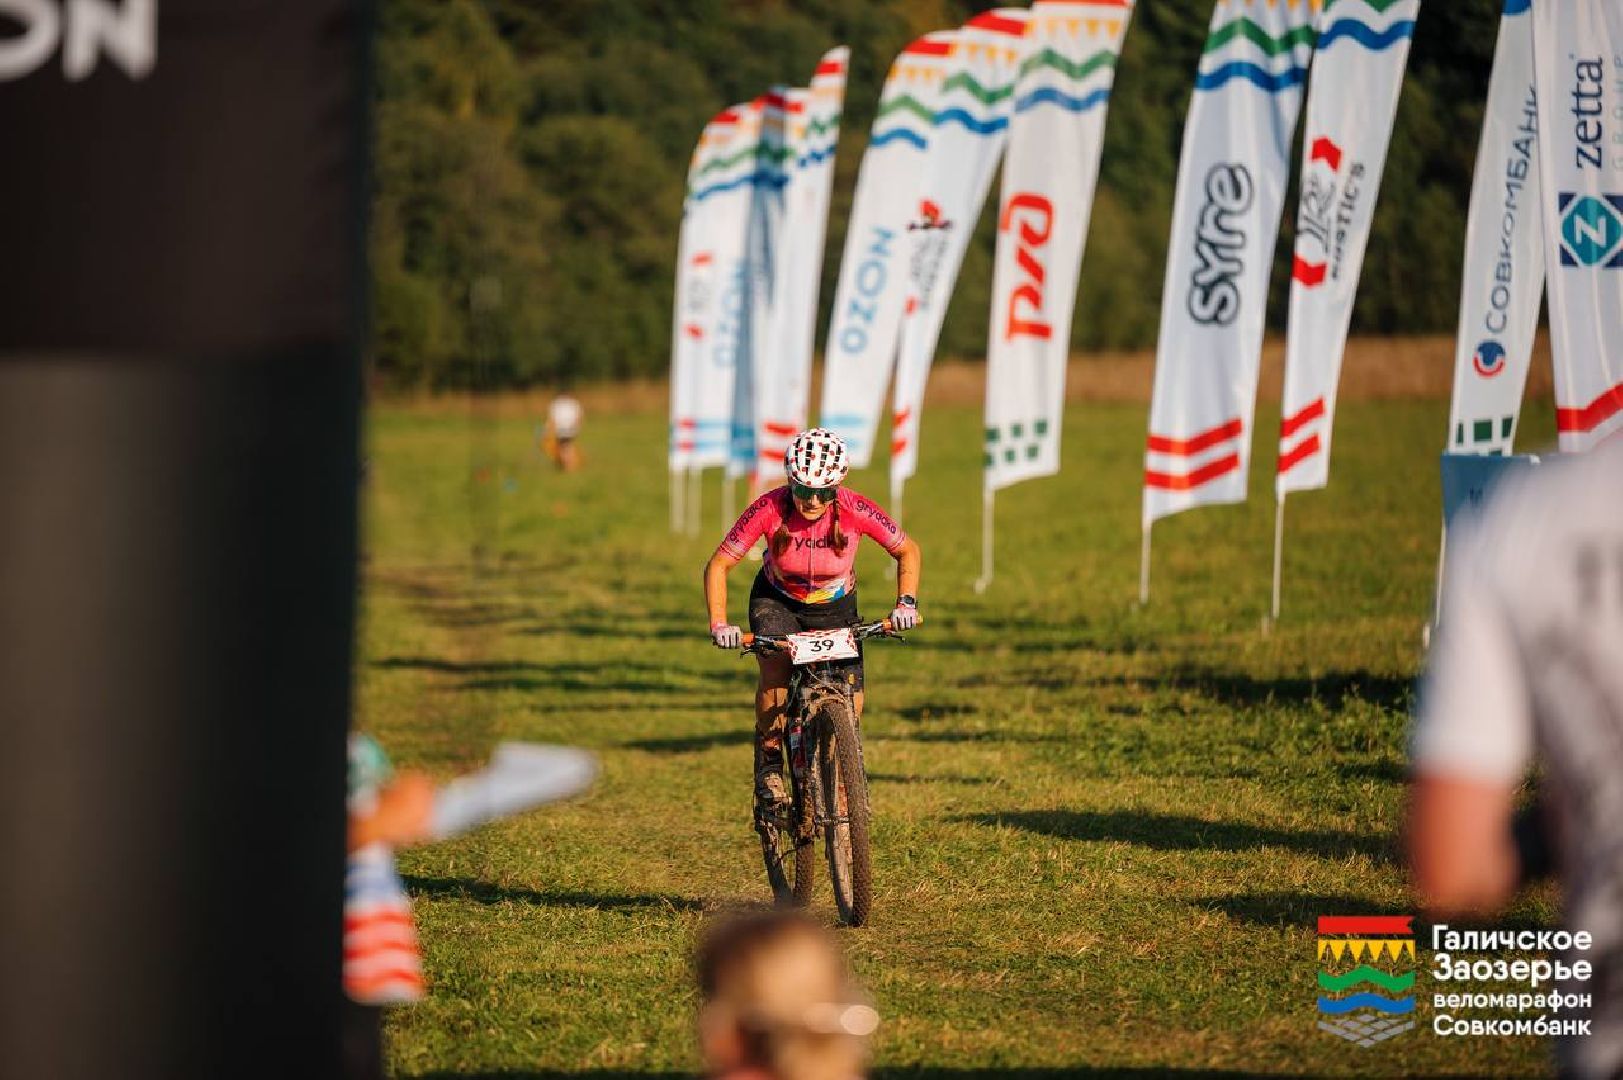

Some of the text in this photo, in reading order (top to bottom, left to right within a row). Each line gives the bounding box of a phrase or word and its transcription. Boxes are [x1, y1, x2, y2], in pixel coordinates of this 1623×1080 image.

[1572, 55, 1602, 169] zetta
[839, 226, 895, 354] OZON
[857, 500, 896, 535] gryadka
[810, 639, 834, 652] 39
